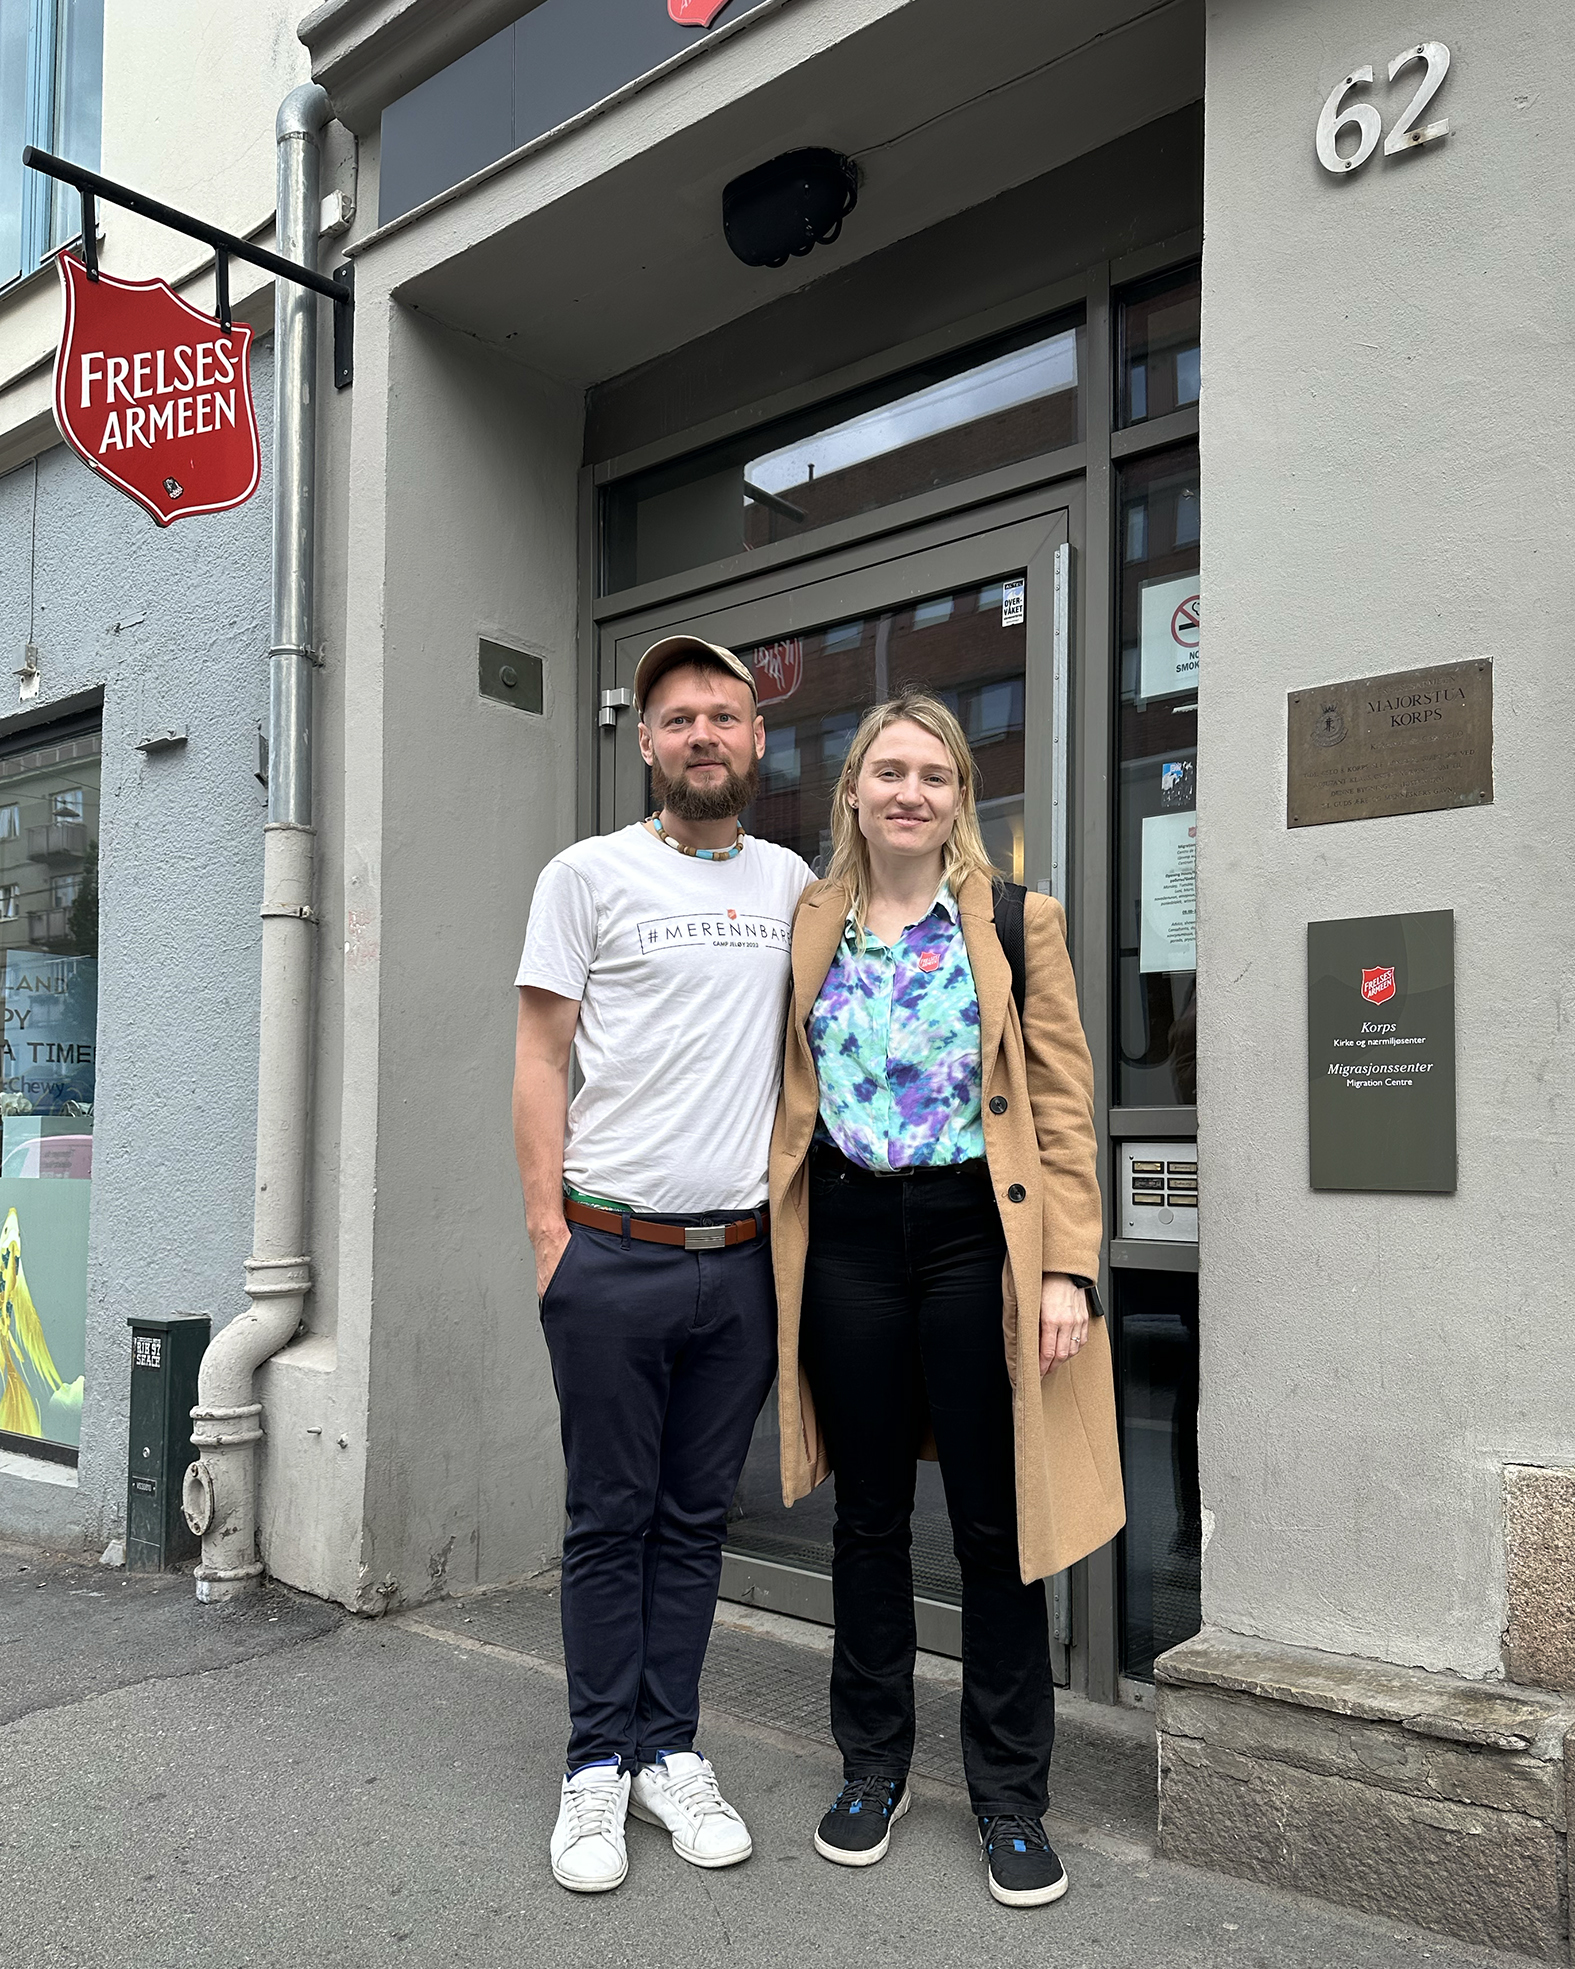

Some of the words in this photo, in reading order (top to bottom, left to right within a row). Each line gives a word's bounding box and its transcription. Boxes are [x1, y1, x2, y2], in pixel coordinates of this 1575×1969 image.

[1316, 41, 1450, 173] 62
[80, 338, 239, 409] FRELSES-
[98, 388, 236, 455] ARMEEN
[1367, 687, 1466, 714] MAJORSTUA
[1390, 707, 1443, 728] KORPS
[1367, 979, 1393, 998] ARMEEN
[1361, 1021, 1397, 1035] Korps
[1333, 1038, 1355, 1047] Kirke
[1356, 1040, 1366, 1048] og
[1368, 1036, 1426, 1047] nærmiljøsenter
[1327, 1062, 1434, 1077] Migrasjonssenter
[1346, 1078, 1383, 1089] Migration
[1384, 1078, 1413, 1086] Centre
